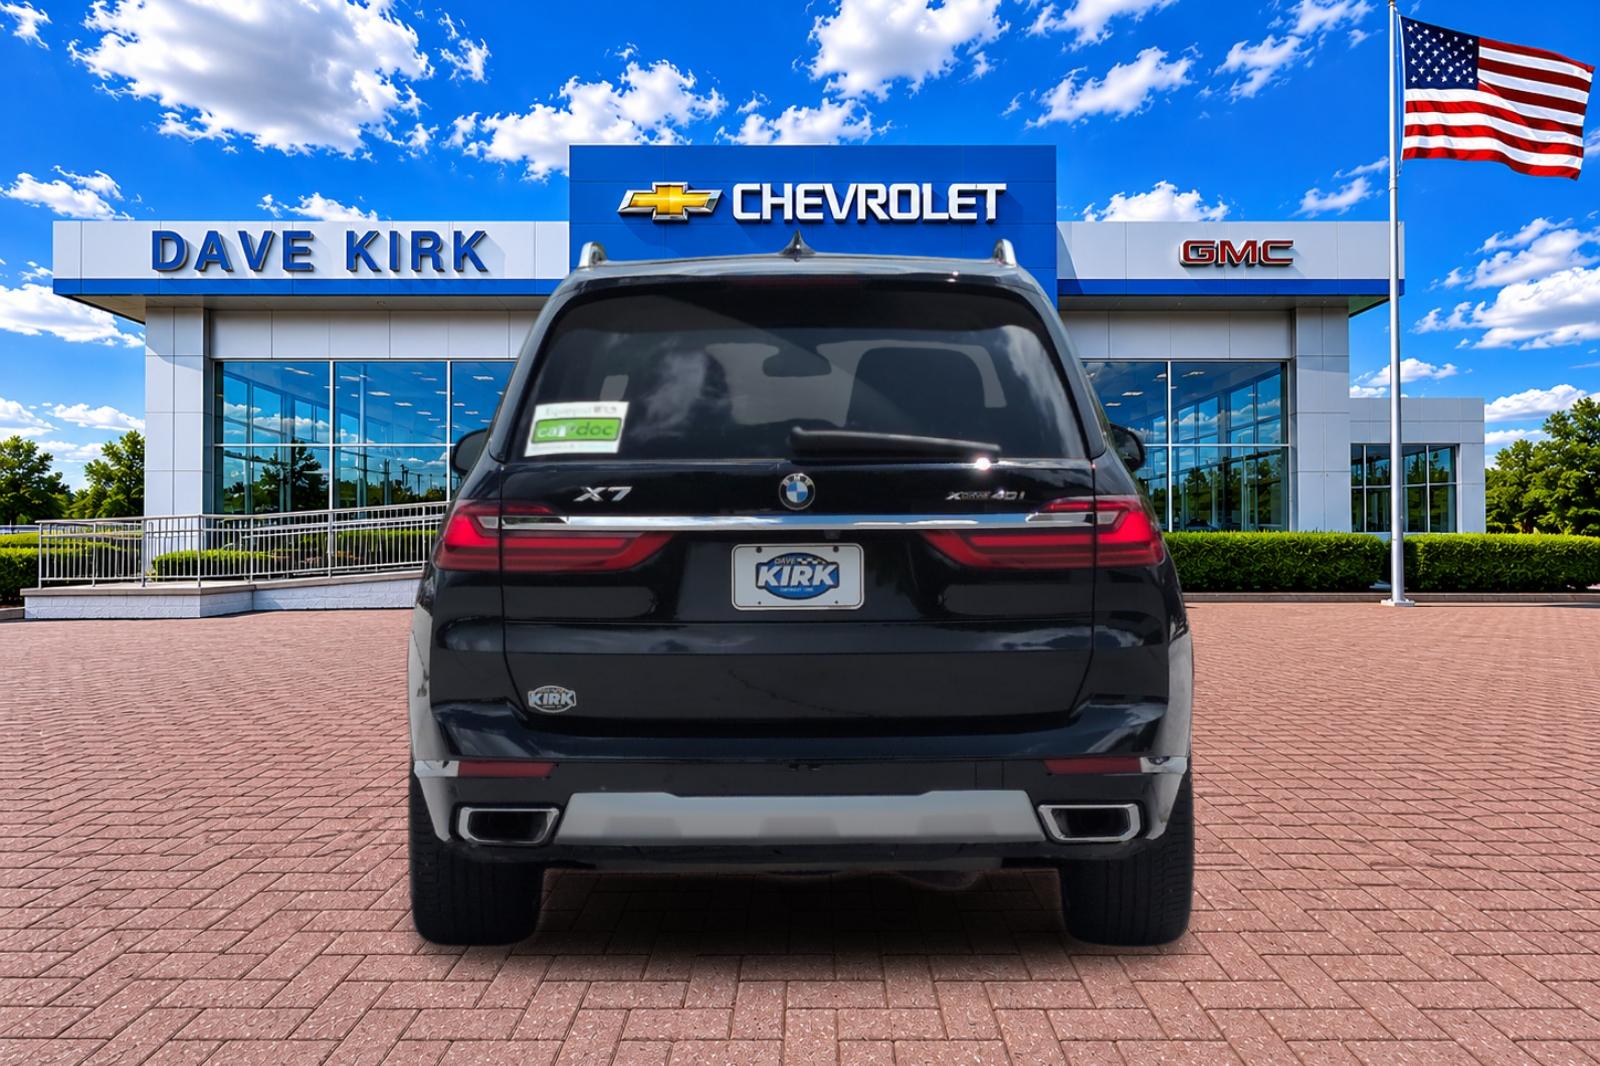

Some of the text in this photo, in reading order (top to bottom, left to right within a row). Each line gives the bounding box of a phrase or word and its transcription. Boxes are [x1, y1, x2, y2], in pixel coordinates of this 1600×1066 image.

[732, 183, 1007, 221] CHEVROLET
[151, 230, 488, 273] DAVE KIRK
[1180, 239, 1294, 267] GMC
[573, 486, 633, 502] X7
[757, 564, 838, 587] KIRK
[530, 692, 574, 705] KIRK
